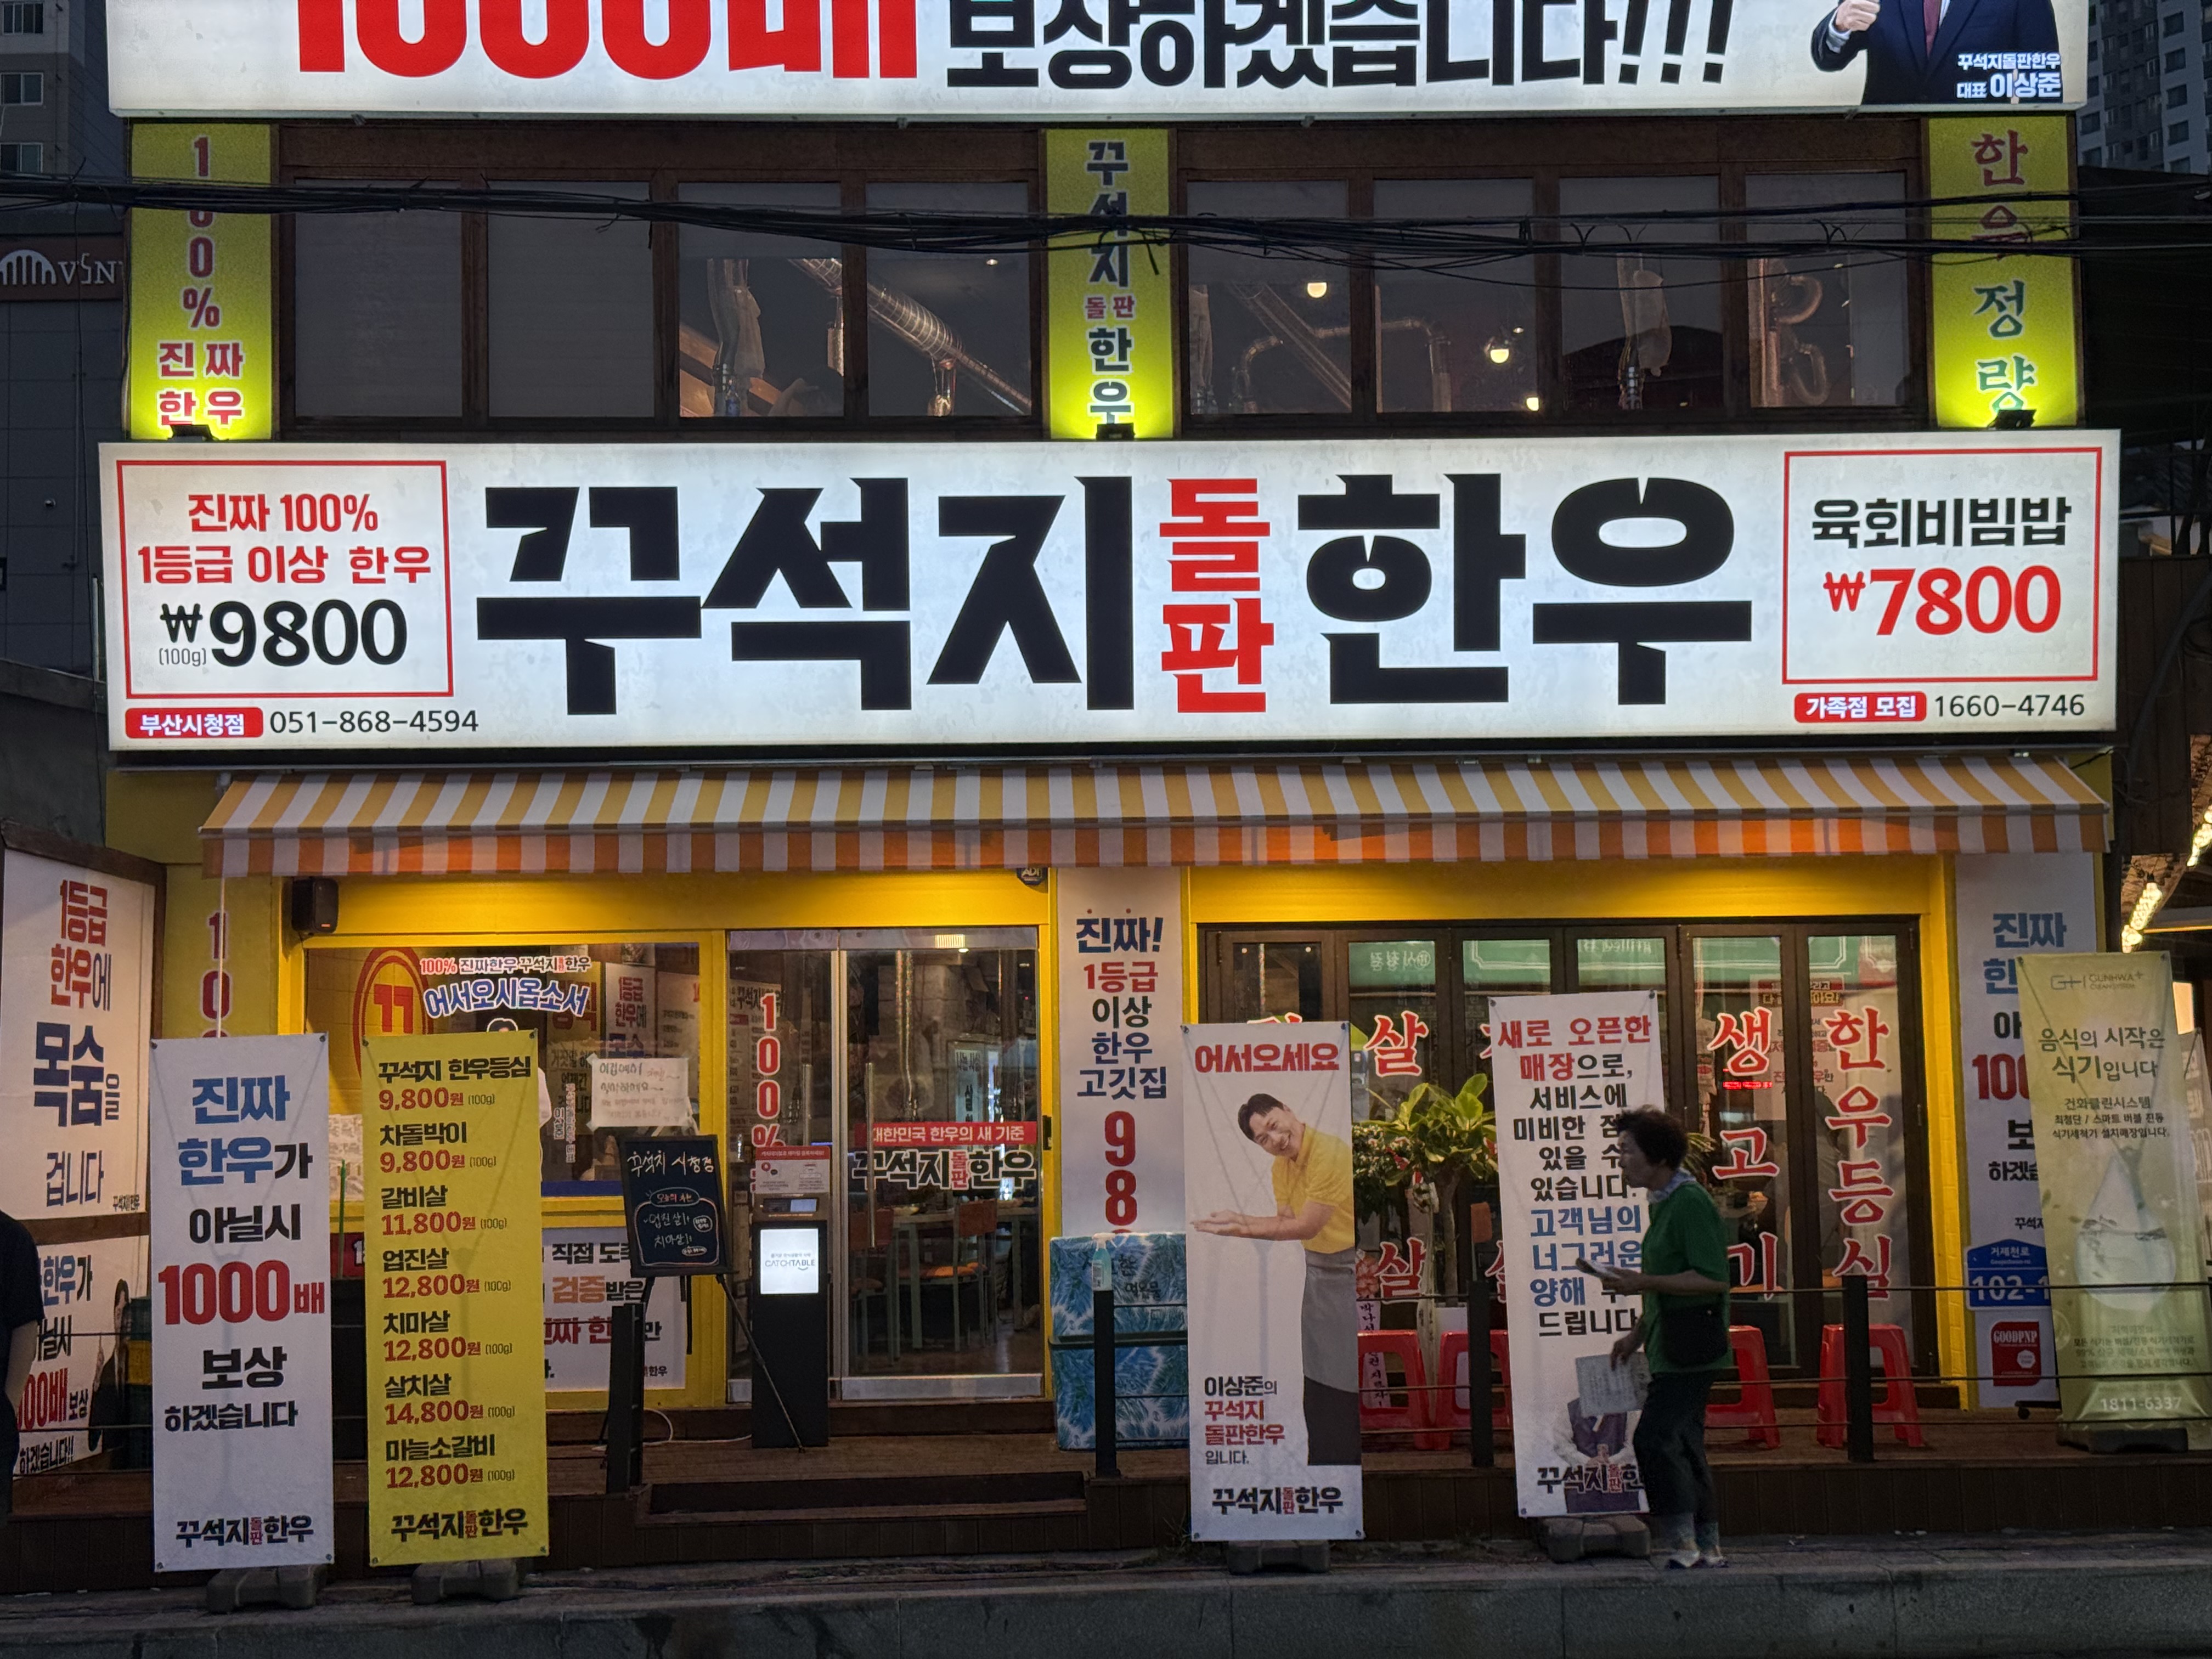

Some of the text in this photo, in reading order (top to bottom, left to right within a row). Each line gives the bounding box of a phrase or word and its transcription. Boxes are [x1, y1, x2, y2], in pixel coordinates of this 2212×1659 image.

[1957, 53, 2061, 71] 꾸석지돌판한우
[1956, 72, 2061, 99] 대표 이상준
[182, 136, 221, 329] 10%
[158, 341, 244, 379] 진짜
[1973, 279, 2036, 413] 정량
[158, 390, 244, 426] 한우
[188, 493, 379, 532] 진짜 100%
[1812, 496, 2073, 549] 육회비빔밥
[138, 545, 431, 584] 1등급 이상 한우
[1823, 565, 2061, 635] ₩7800
[160, 599, 407, 667] ₩9800
[159, 647, 207, 667] (100g)
[1806, 694, 2085, 719] 가족점 모집 1660-4746
[140, 710, 479, 736] 부산시청점 051-868-4594
[1076, 917, 1164, 953] 진짜!
[1993, 912, 2067, 949] 진짜
[50, 943, 112, 1012] 한우에
[202, 911, 230, 1037] 10
[421, 957, 457, 974] 100%
[459, 956, 518, 974] 진짜한우
[1084, 961, 1159, 993] 1등급
[424, 978, 590, 1019] 어서오시옵소서
[1092, 996, 1152, 1029] 이상
[1498, 1015, 1652, 1048] 새로 오픈한
[2038, 1027, 2165, 1052] 음식의 시작은
[1091, 1032, 1153, 1064] 한우
[1195, 1043, 1339, 1074] 어서오세요
[33, 1021, 121, 1127] 목숨을
[379, 1060, 441, 1084] 꾸석지
[448, 1056, 532, 1080] 한우등심
[1520, 1053, 1633, 1081] 매장으로,
[2052, 1055, 2158, 1084] 식기입니다
[1077, 1066, 1167, 1101] 고깃집
[1530, 1083, 1627, 1110] 서비스에
[192, 1074, 290, 1125] 진짜
[379, 1087, 495, 1111] 9,800원 (100g)
[380, 1121, 467, 1147] 차돌박이
[930, 1126, 973, 1142] 한우의
[977, 1126, 992, 1142] 새
[996, 1125, 1025, 1141] 기준
[1514, 1115, 1585, 1142] 미비한
[178, 1136, 313, 1186] 한우가
[380, 1149, 496, 1173] 9,800원 (100g)
[1104, 1111, 1138, 1233] 98
[1539, 1145, 1587, 1171] 있을
[46, 1149, 105, 1206] 겁니다
[1531, 1175, 1637, 1202] 있습니다.
[381, 1185, 448, 1210] 갈비살
[189, 1203, 301, 1244] 아닐시
[381, 1211, 507, 1237] 11,800원 (100g)
[1531, 1205, 1642, 1238] 고객님의
[382, 1248, 449, 1272] 업진살
[552, 1243, 593, 1265] 직접
[1991, 1246, 2030, 1259] 거제천로
[158, 1260, 325, 1326] 1000배
[382, 1274, 511, 1299] 12,800원 (100g)
[552, 1276, 643, 1304] 검증받은
[1530, 1277, 1585, 1307] 양해
[383, 1310, 450, 1335] 치마살
[37, 1314, 72, 1362] 닐시
[383, 1336, 512, 1362] 12,800원 (100g)
[202, 1346, 287, 1390] 보상
[385, 1373, 452, 1398] 살치살
[1204, 1376, 1277, 1396] 이상준의
[69, 1389, 88, 1420] 보상
[164, 1401, 298, 1432] 하겠습니다
[385, 1400, 515, 1425] 14,800원 (100g)
[1204, 1400, 1265, 1421] 꾸석지
[2100, 1396, 2182, 1412] 1811-6337
[386, 1434, 495, 1462] 마늘소갈비
[1205, 1424, 1285, 1446] 돌판한우
[1205, 1450, 1250, 1465] 입니다.
[386, 1463, 515, 1488] 12,800원 (100g)
